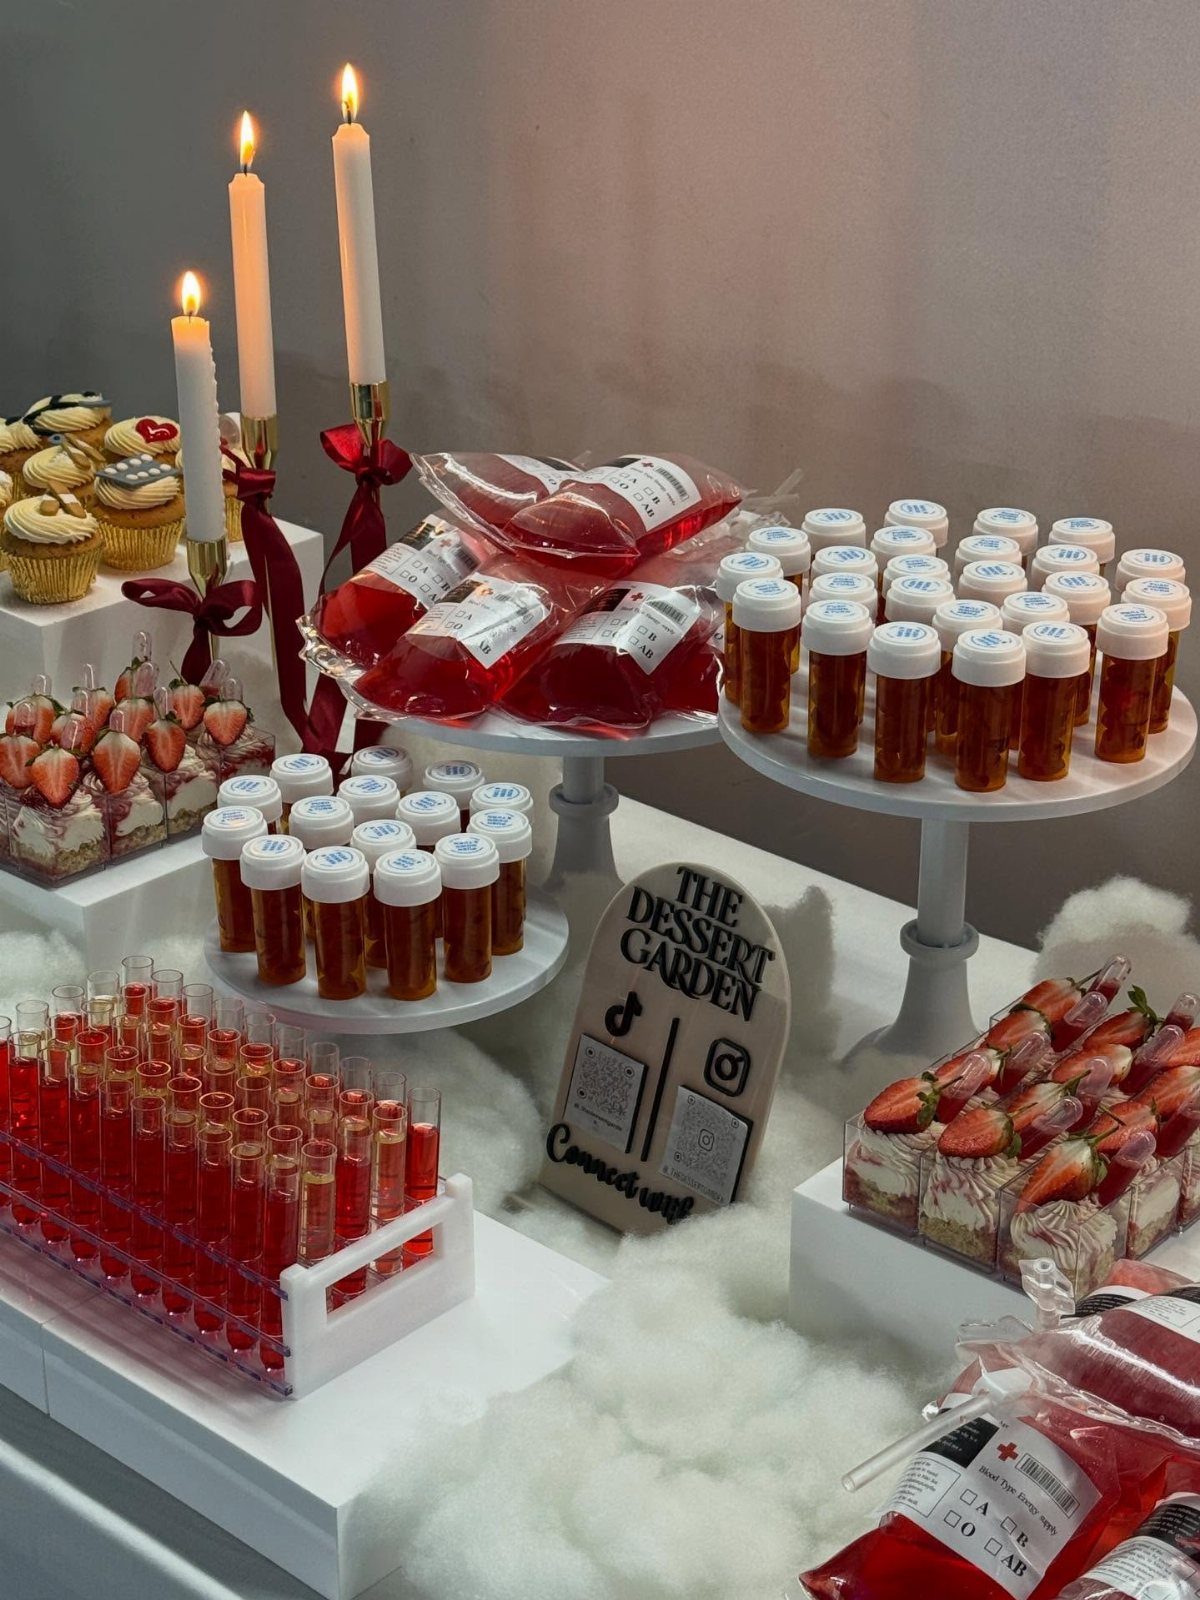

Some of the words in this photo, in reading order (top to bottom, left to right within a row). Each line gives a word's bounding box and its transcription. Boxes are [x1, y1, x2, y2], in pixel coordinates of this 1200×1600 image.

[641, 504, 655, 517] AB
[441, 582, 451, 592] B
[638, 644, 654, 659] AB
[648, 632, 657, 642] B
[676, 866, 743, 927] THE
[626, 886, 775, 983] DESSERT
[620, 928, 761, 1022] GARDEN
[546, 1123, 640, 1199] Connect
[976, 1502, 989, 1516] A
[1016, 1532, 1029, 1547] B
[979, 1465, 1000, 1481] Blood
[1000, 1478, 1017, 1495] Type
[1017, 1492, 1039, 1516] Energy
[1040, 1515, 1058, 1536] supply
[961, 1522, 976, 1537] O
[1001, 1554, 1027, 1577] AB
